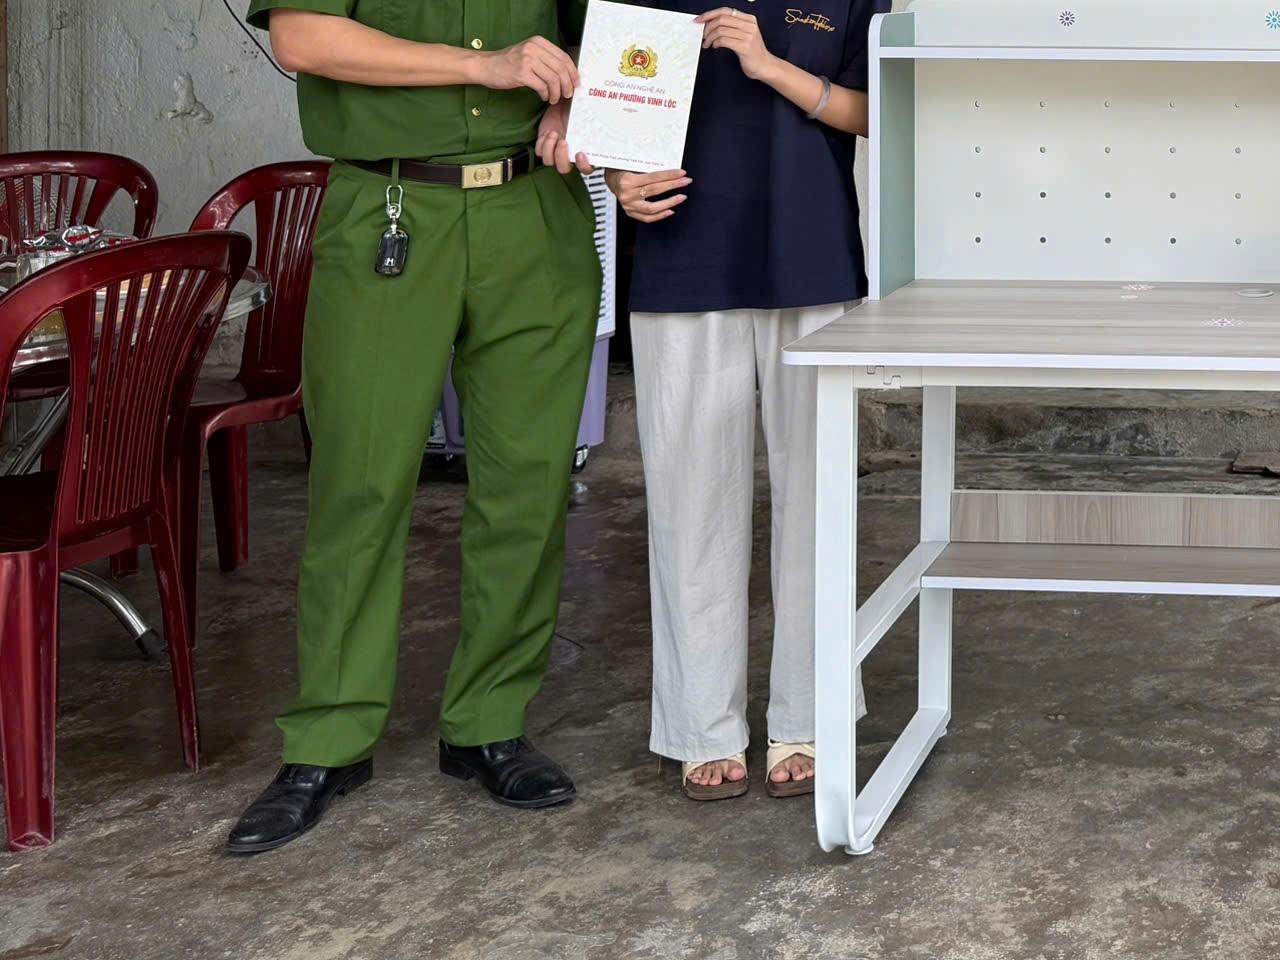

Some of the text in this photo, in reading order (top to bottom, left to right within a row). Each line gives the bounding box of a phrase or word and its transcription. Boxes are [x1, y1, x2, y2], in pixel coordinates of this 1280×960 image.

[604, 80, 625, 89] CÔNG
[626, 83, 637, 91] AN
[589, 88, 607, 98] CÔNG
[608, 92, 618, 100] AN
[647, 98, 663, 107] VINH
[663, 99, 677, 109] LỘC
